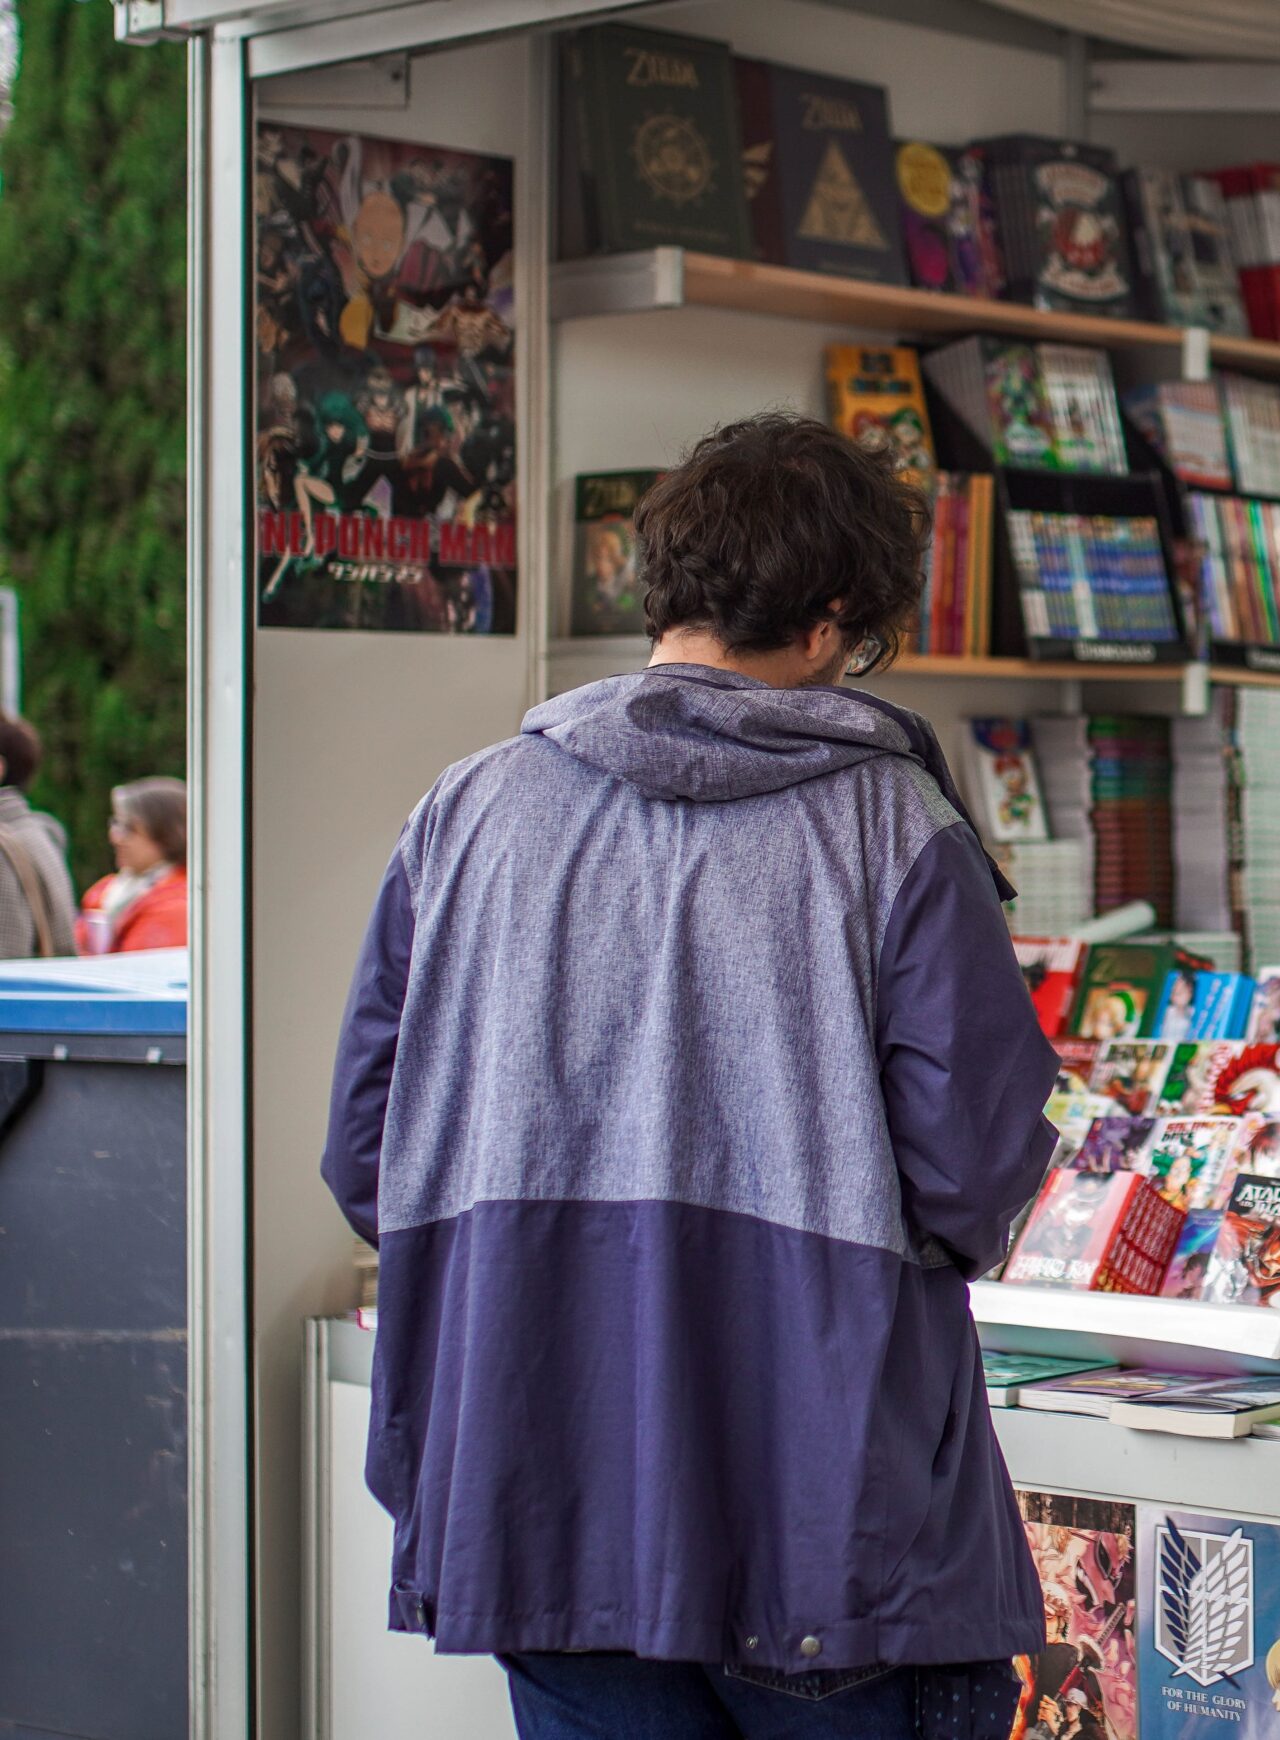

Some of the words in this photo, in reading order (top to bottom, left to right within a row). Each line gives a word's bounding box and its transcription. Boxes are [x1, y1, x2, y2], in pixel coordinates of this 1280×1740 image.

[1161, 1686, 1184, 1699] FOR
[1186, 1690, 1209, 1703] THE
[1212, 1695, 1247, 1710] GLORY
[1167, 1700, 1182, 1711] OF
[1184, 1703, 1241, 1722] HUMANITY
